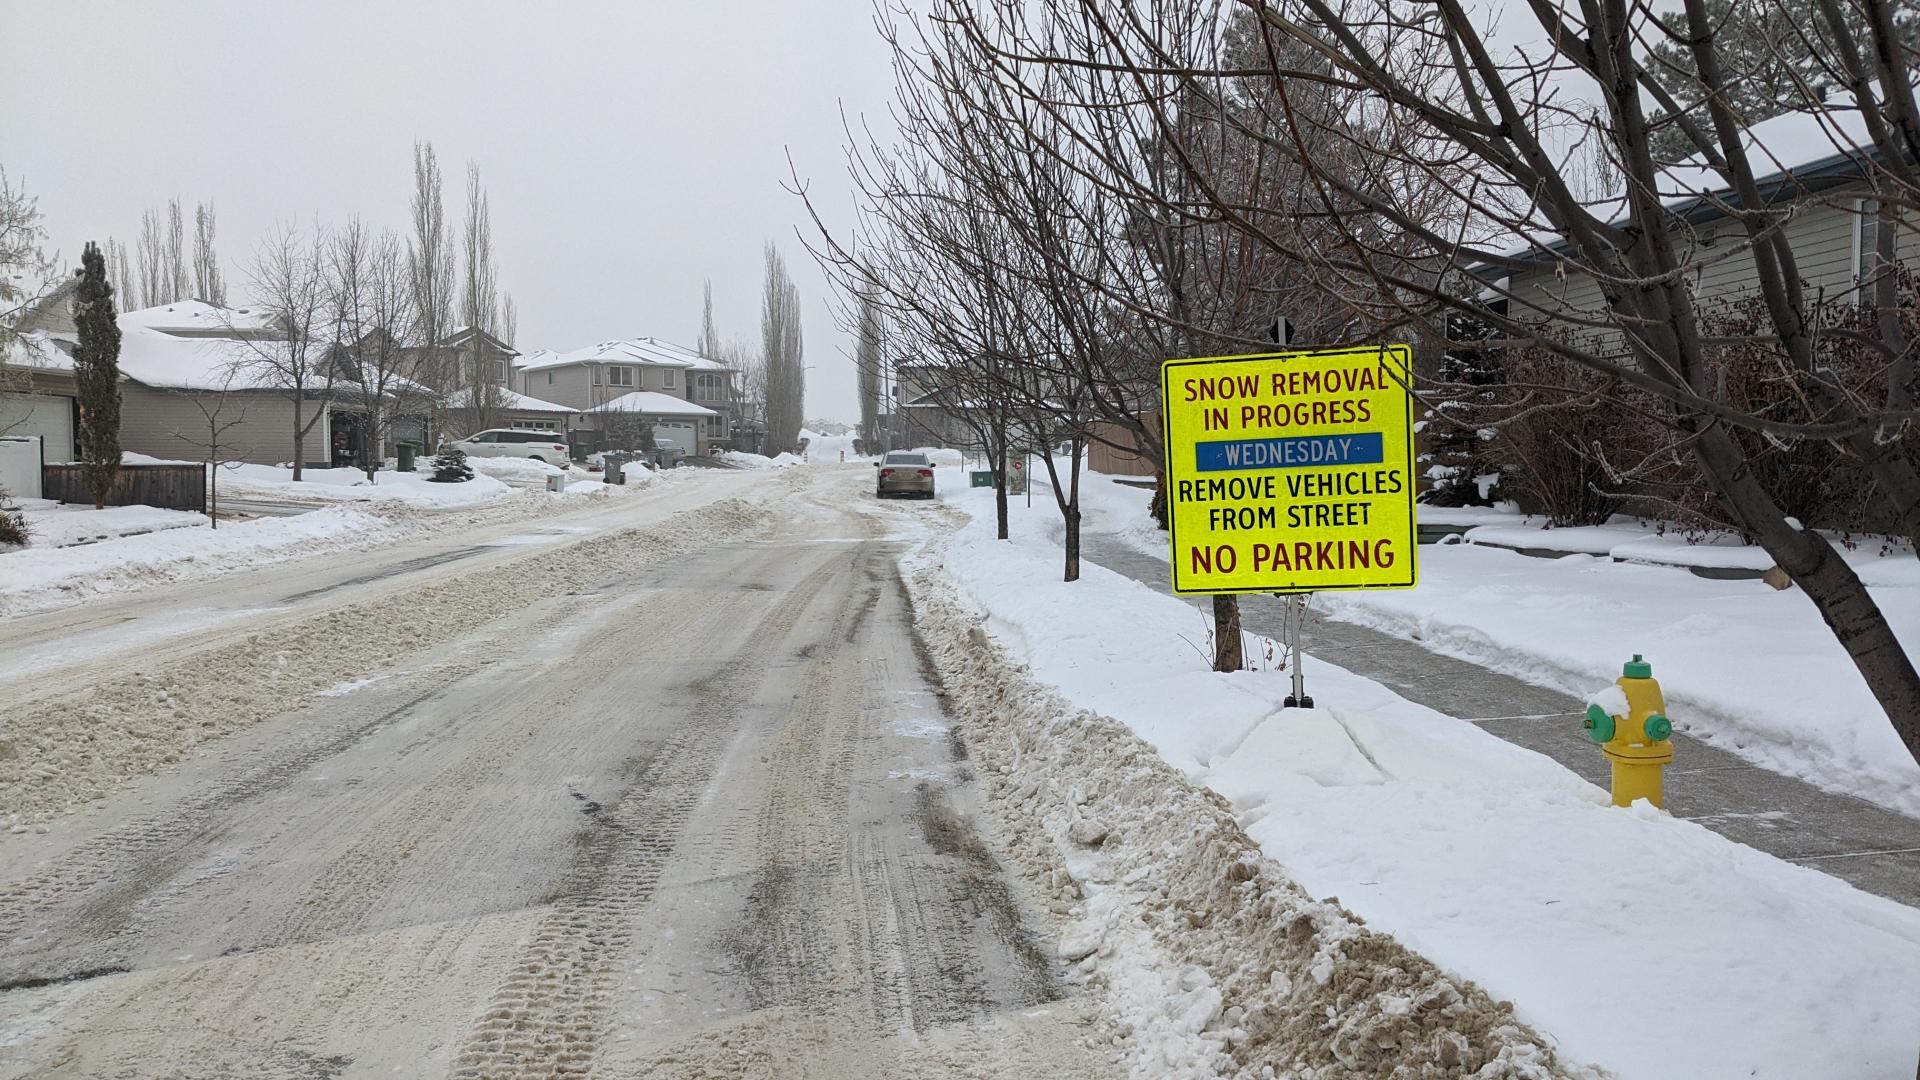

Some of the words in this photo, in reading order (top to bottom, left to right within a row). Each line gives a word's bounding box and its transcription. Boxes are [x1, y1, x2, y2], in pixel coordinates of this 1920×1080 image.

[1185, 375, 1259, 402] SNOW
[1272, 366, 1389, 397] REMOVAL
[1204, 407, 1229, 431] IN
[1241, 399, 1371, 429] PROGRESS
[1225, 438, 1351, 466] WEDNESDAY
[1179, 476, 1276, 502] REMOVE
[1287, 470, 1402, 498] VEHICLES
[1209, 507, 1276, 531] FROM
[1288, 502, 1372, 528] STREET
[1191, 545, 1237, 574] NO
[1253, 539, 1395, 572] PARKING
